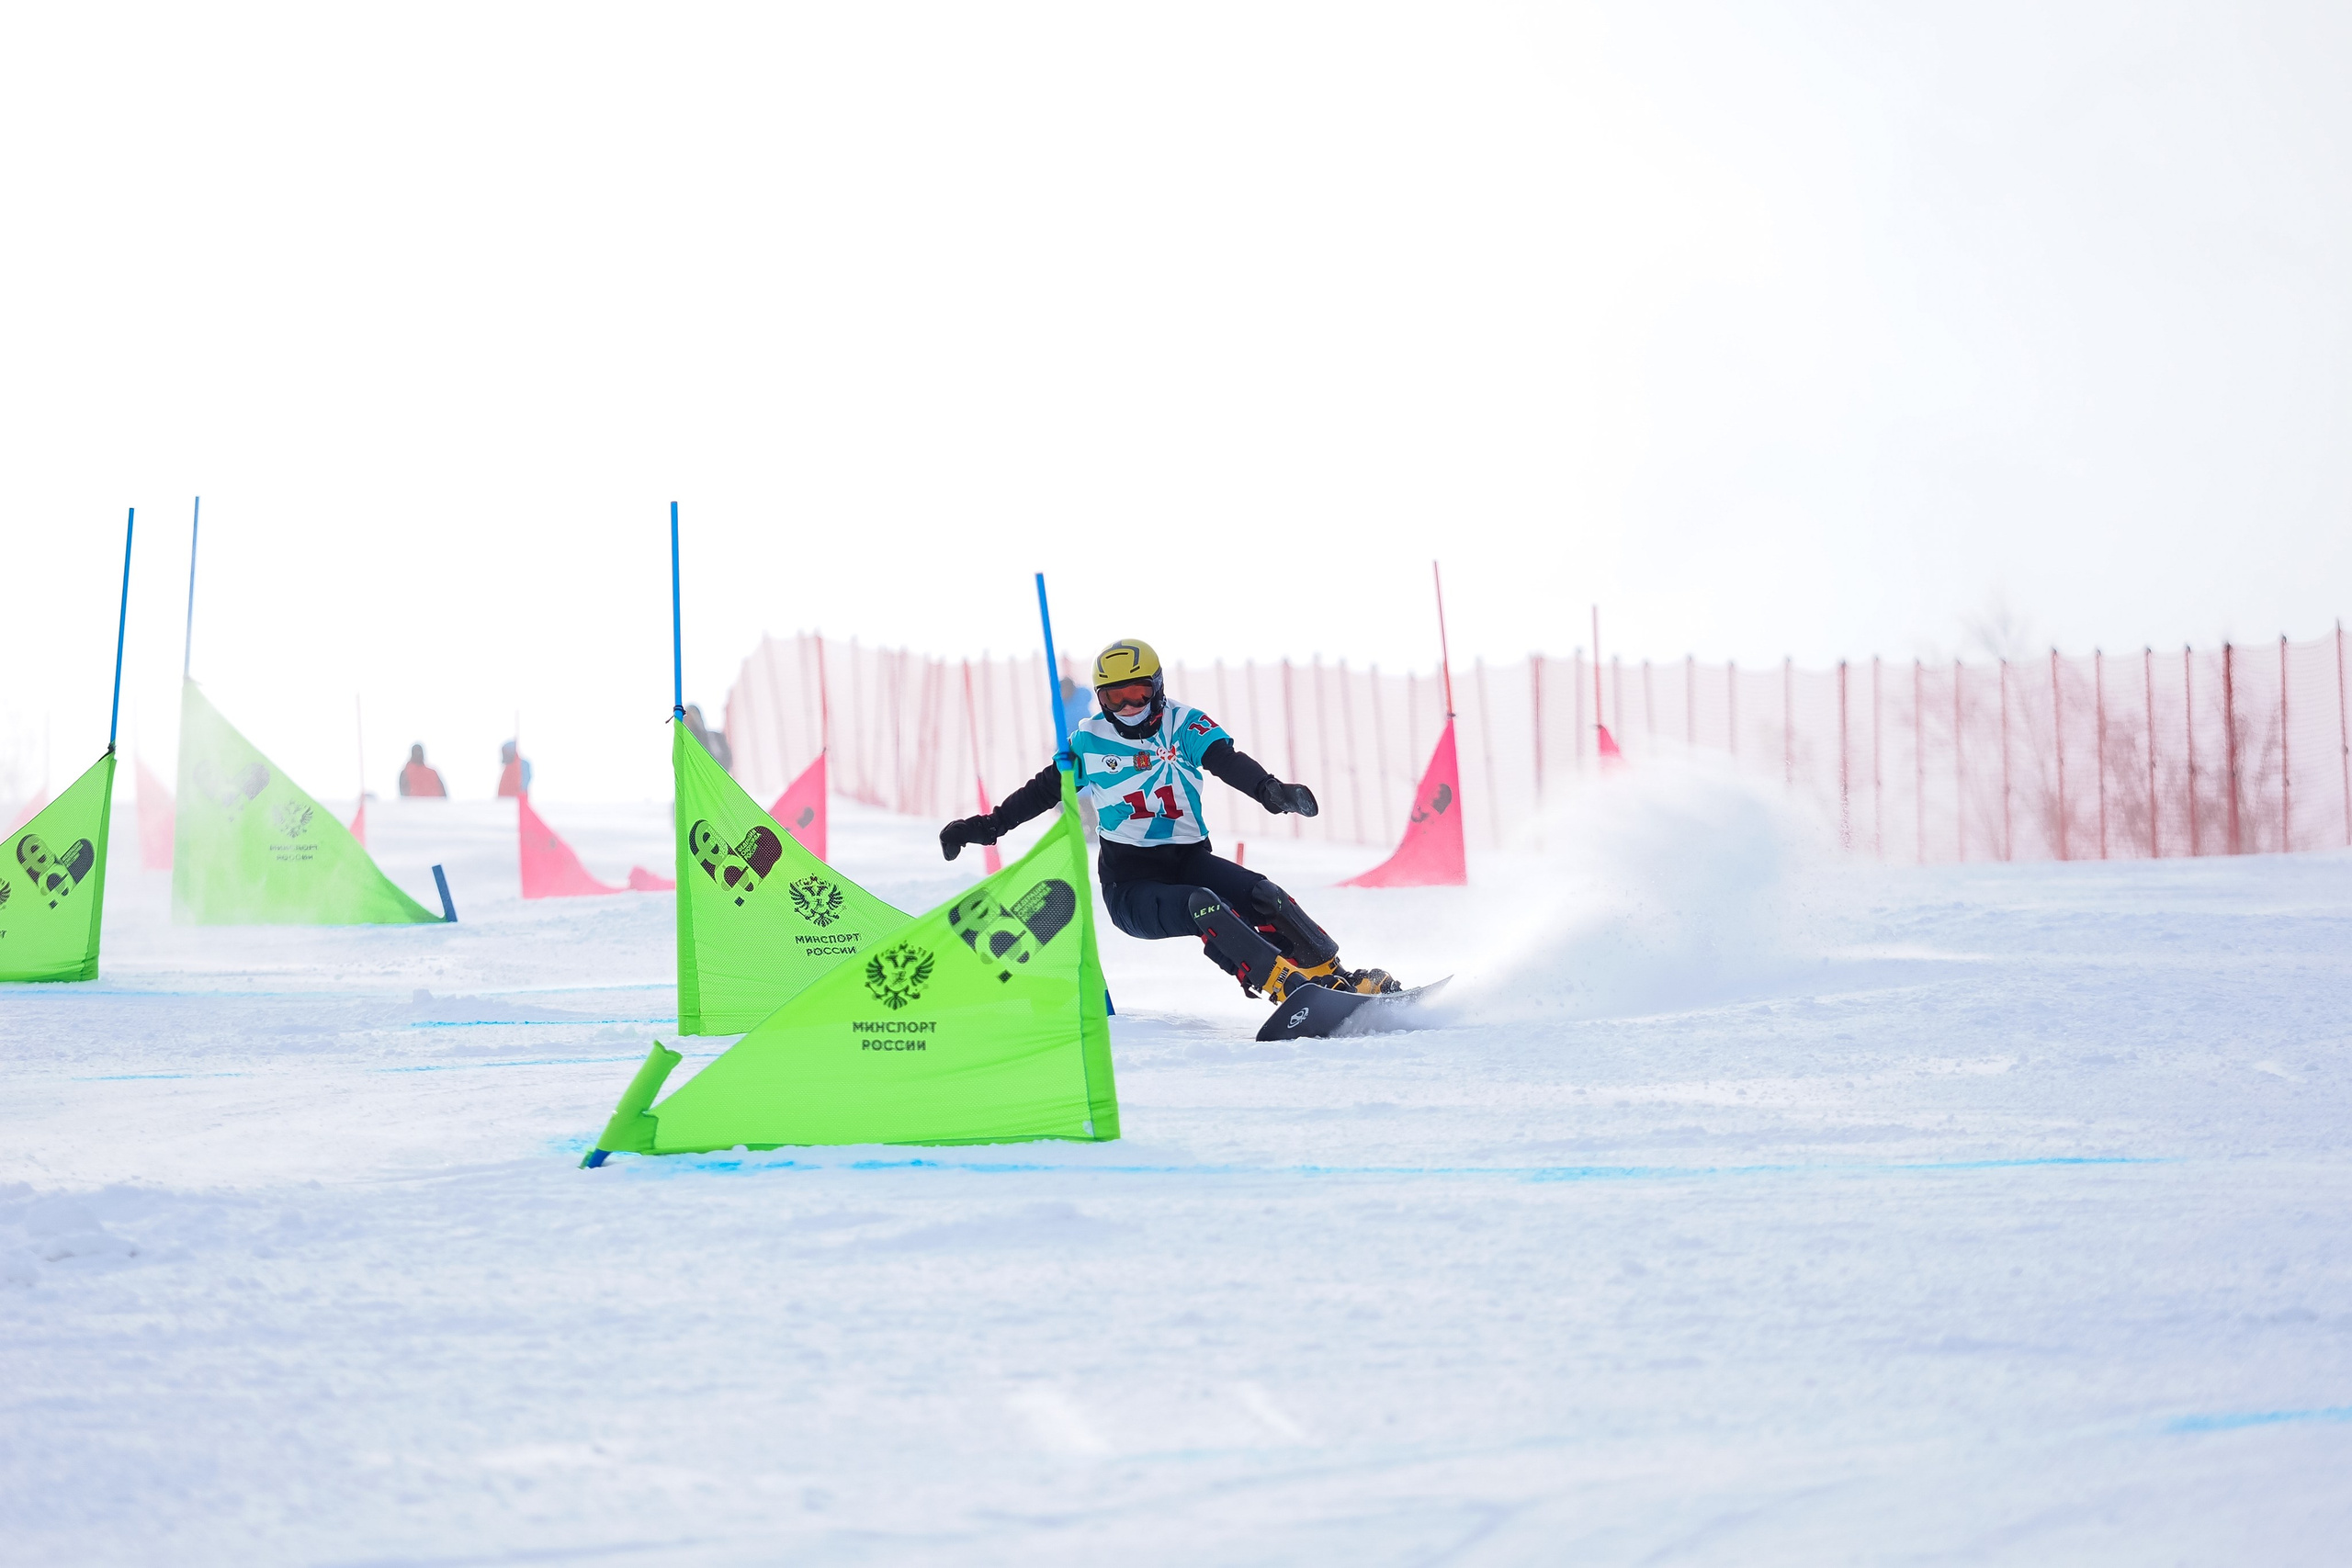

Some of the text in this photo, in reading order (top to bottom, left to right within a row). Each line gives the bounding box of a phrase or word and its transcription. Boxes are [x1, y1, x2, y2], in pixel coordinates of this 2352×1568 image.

[1189, 715, 1219, 735] 11
[1123, 784, 1184, 820] 11
[1194, 904, 1221, 919] LEKI
[795, 932, 861, 944] МИНСПОРТ
[807, 946, 856, 956] РОССИИ
[853, 1021, 937, 1034] МИНСПОРТ
[861, 1039, 927, 1052] РОССИИ
